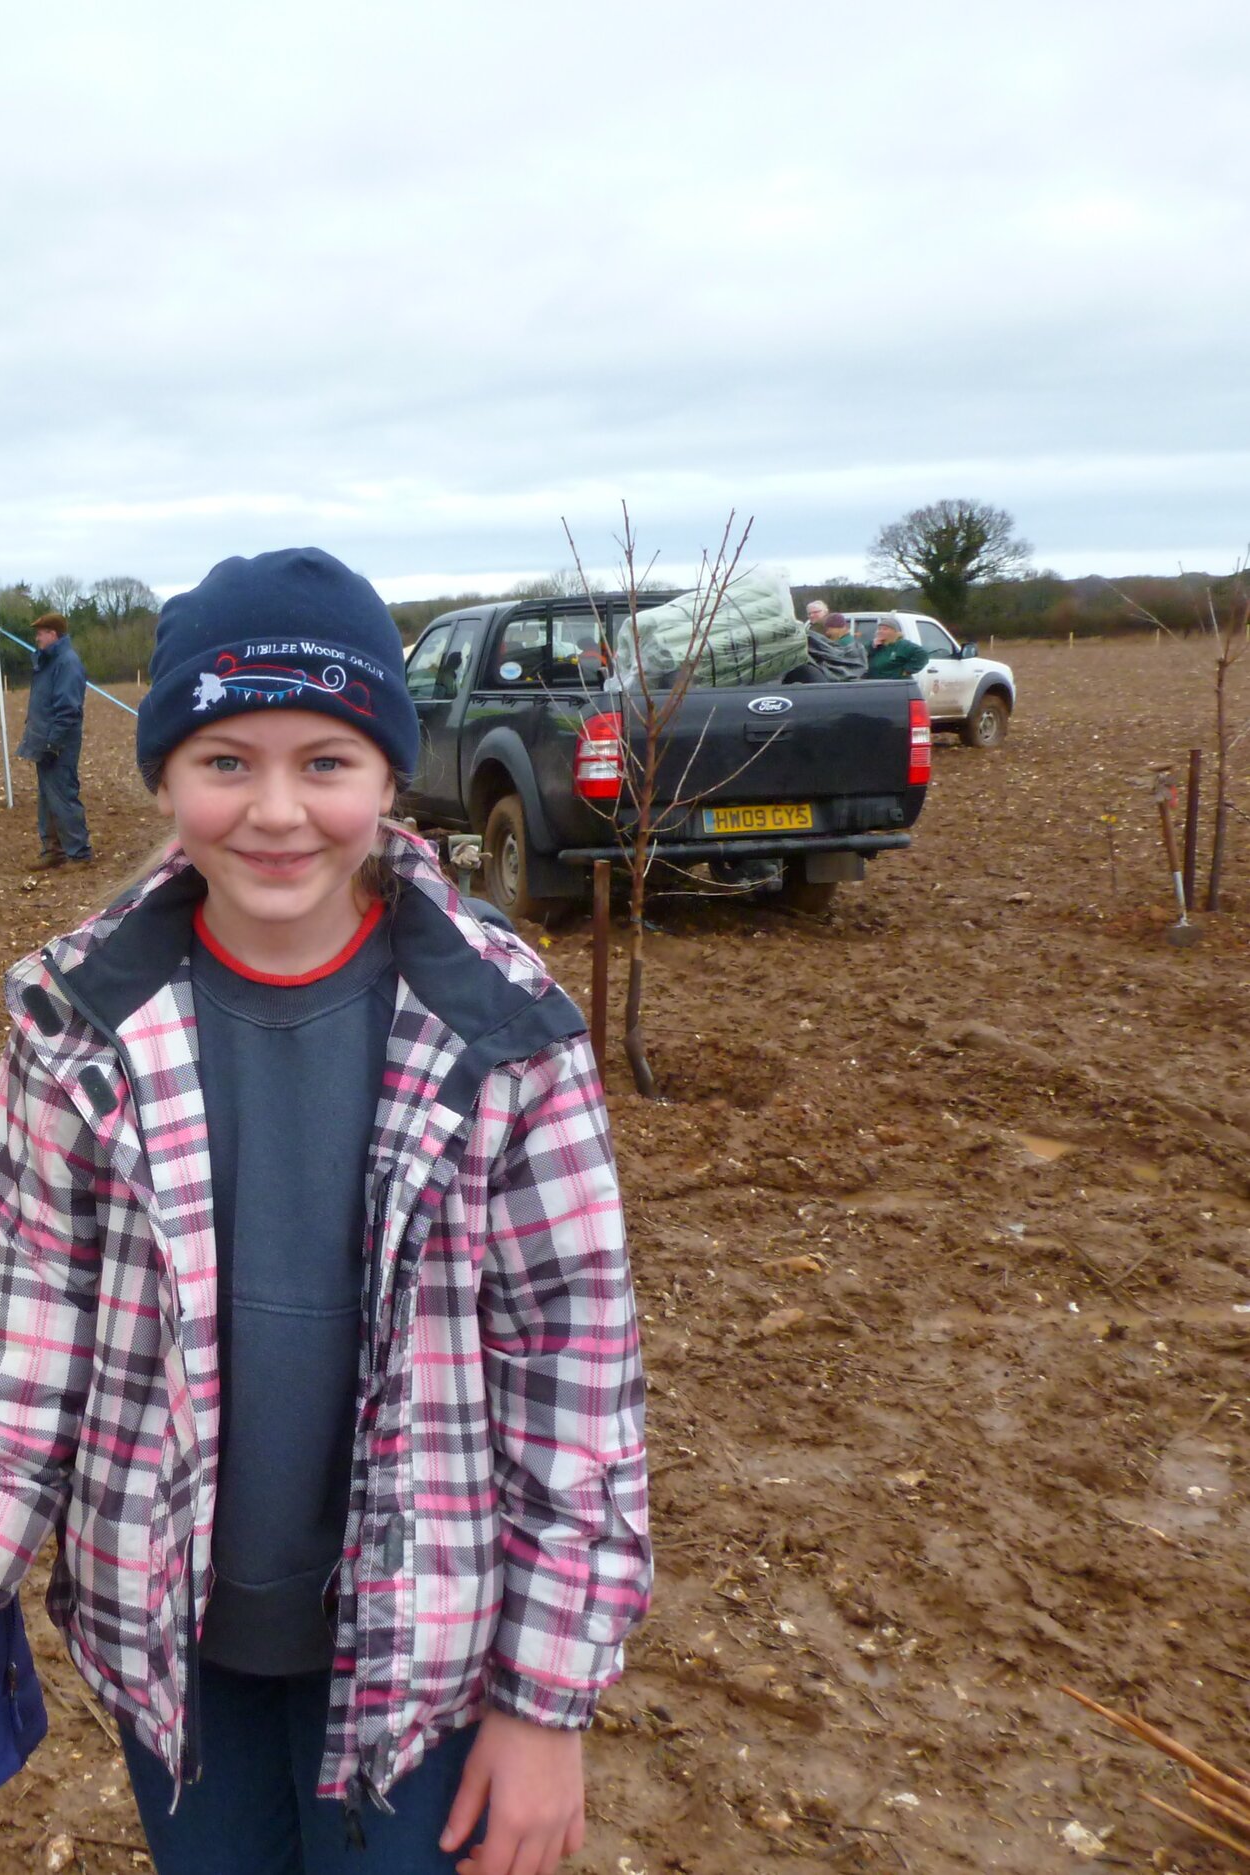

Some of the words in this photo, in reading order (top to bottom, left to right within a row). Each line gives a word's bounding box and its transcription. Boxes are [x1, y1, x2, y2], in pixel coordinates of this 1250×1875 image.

[244, 643, 298, 658] JUBILEE
[300, 641, 346, 660] WOODS
[758, 700, 783, 711] Ford
[715, 808, 766, 829] HW09
